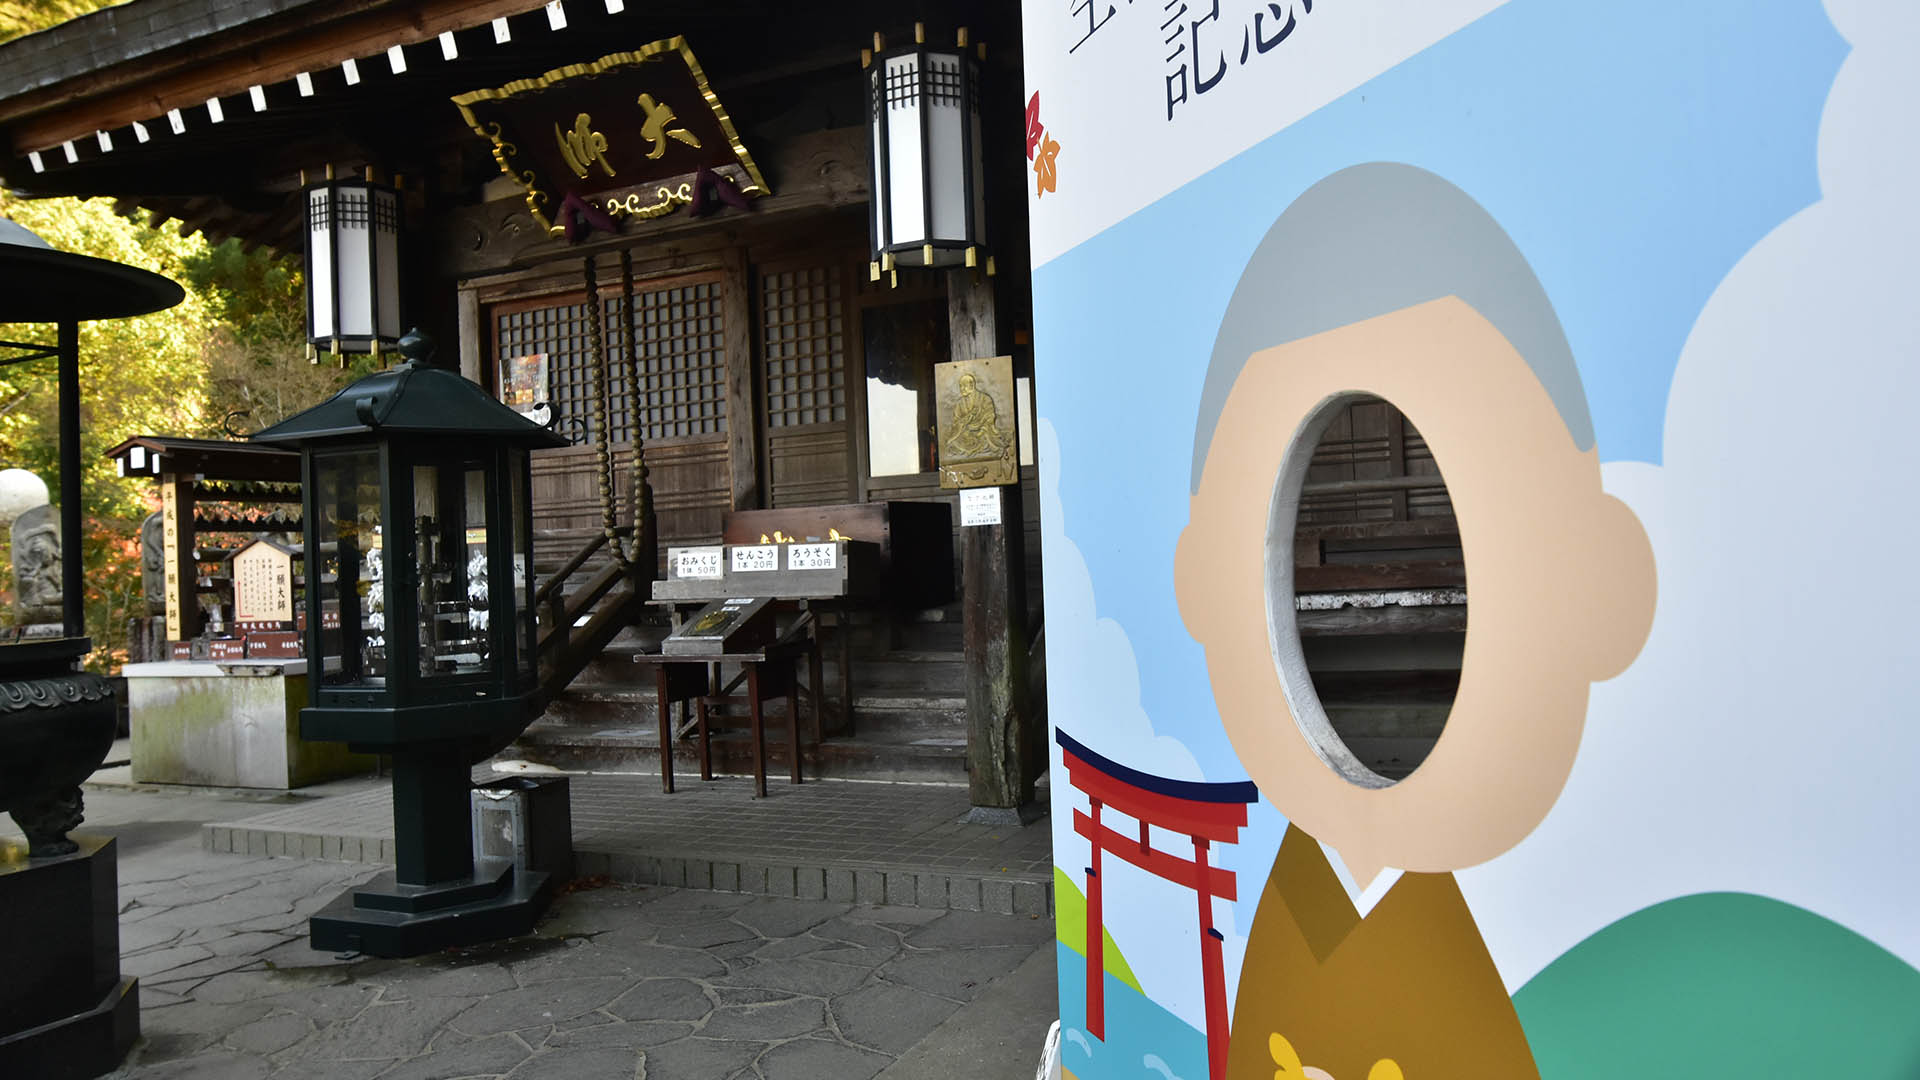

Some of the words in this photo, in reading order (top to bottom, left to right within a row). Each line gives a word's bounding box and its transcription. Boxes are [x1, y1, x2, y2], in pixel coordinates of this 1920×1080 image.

[736, 549, 774, 560] せんこう
[793, 547, 831, 558] ろうそく
[681, 556, 717, 566] おみくじ
[737, 561, 749, 569] 1本
[753, 560, 773, 569] 20円
[793, 559, 806, 567] 1本
[810, 558, 831, 567] 30円
[697, 566, 717, 575] 50円
